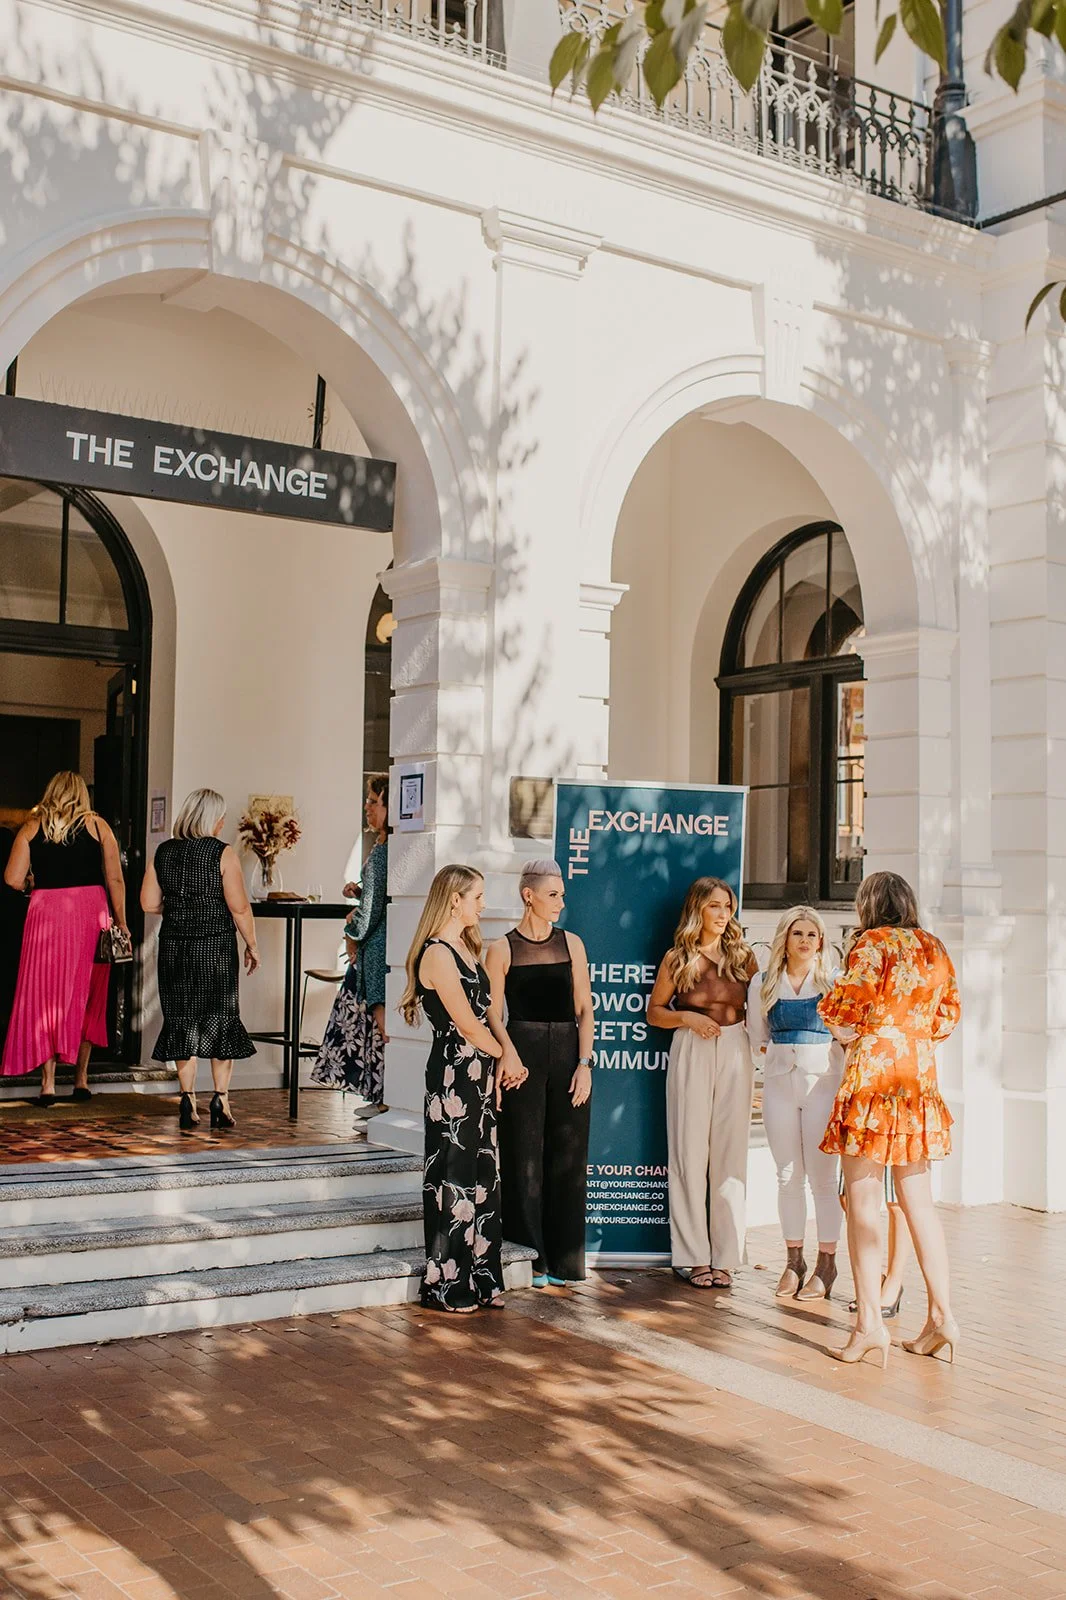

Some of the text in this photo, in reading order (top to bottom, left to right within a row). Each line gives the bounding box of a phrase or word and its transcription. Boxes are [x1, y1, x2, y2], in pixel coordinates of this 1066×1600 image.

[66, 431, 328, 499] THE EXCHANGE
[588, 810, 729, 836] EXCHANGE
[567, 827, 590, 879] THE
[587, 963, 656, 984] HERE
[596, 1165, 632, 1176] YOUR
[635, 1165, 669, 1176] CHAN
[586, 1191, 664, 1200] OUREXCHANGE.CO
[585, 1203, 664, 1211] OUREXCHANGE.CO
